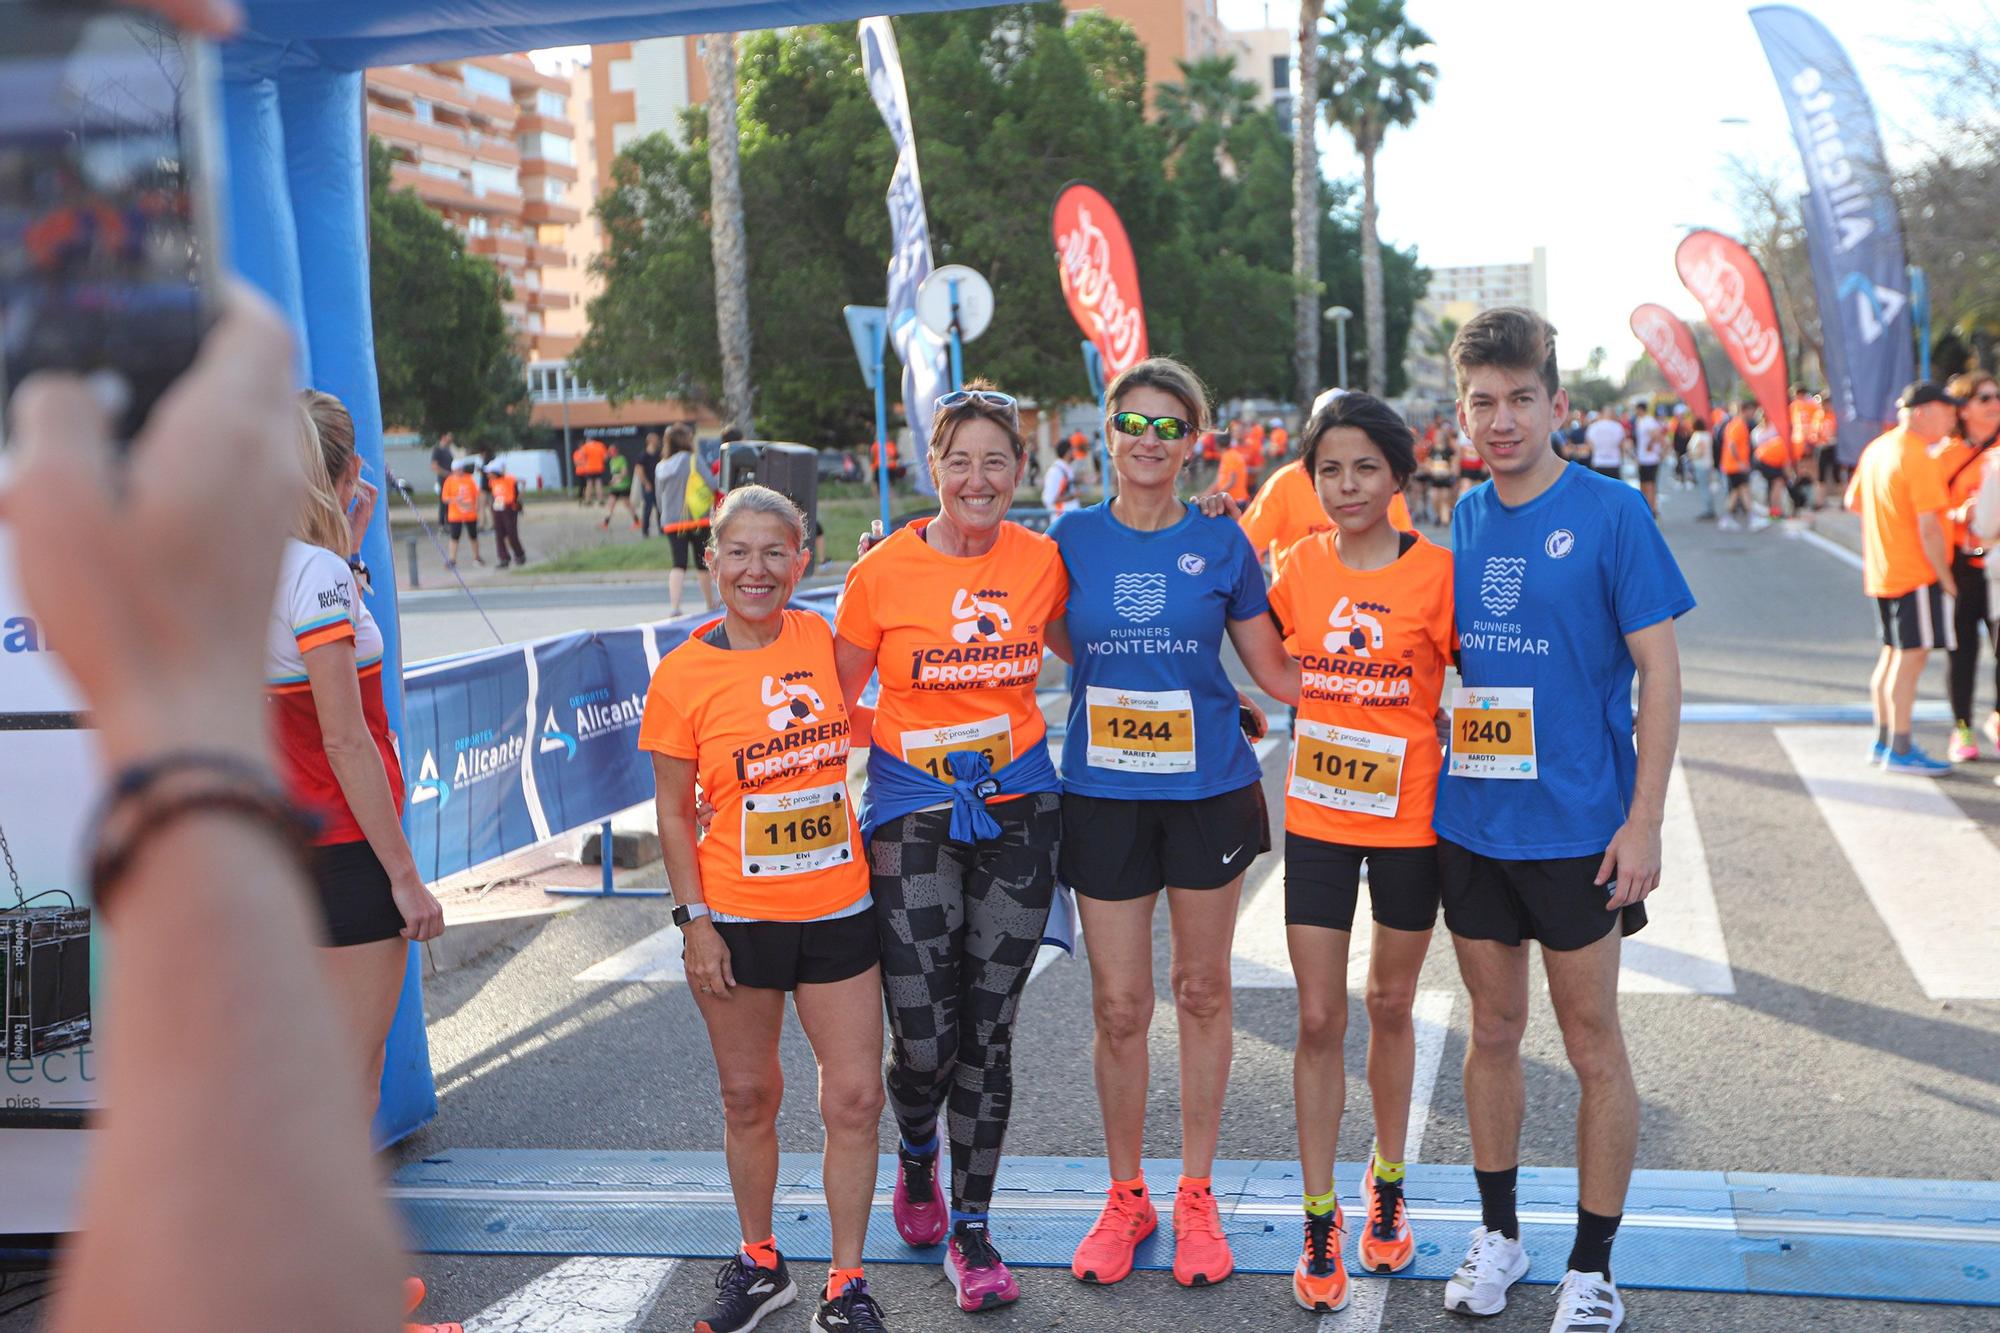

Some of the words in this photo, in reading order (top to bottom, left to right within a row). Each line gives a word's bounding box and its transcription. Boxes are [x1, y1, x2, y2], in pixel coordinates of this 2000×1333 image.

[1110, 627, 1171, 638] RUNNERS
[1473, 620, 1522, 634] RUNNERS
[924, 641, 1039, 664] CARRERA
[1087, 639, 1198, 655] MONTEMAR
[921, 657, 1038, 682] PROSOLIA
[1302, 655, 1413, 678] CARRERA
[911, 680, 987, 691] ALICANTE
[1301, 672, 1410, 697] PROSOLIA
[569, 687, 609, 710] DEPORTES
[1302, 690, 1351, 703] LICANTE
[1361, 696, 1409, 707] MUJER
[455, 728, 493, 752] DEPORTES
[746, 719, 850, 760] CARRERA
[949, 727, 980, 739] prosolia
[1108, 717, 1172, 741] 1244
[1340, 734, 1371, 744] prosolia
[1462, 719, 1512, 743] 1240
[454, 735, 524, 782] Alicante
[926, 748, 994, 778] 106
[1122, 750, 1157, 758] MARIETA
[1313, 751, 1378, 782] 1017
[793, 792, 820, 805] prosolia
[764, 815, 832, 844] 1166
[795, 852, 811, 860] Elvi
[6, 1045, 95, 1084] ect
[6, 1094, 40, 1109] pies
